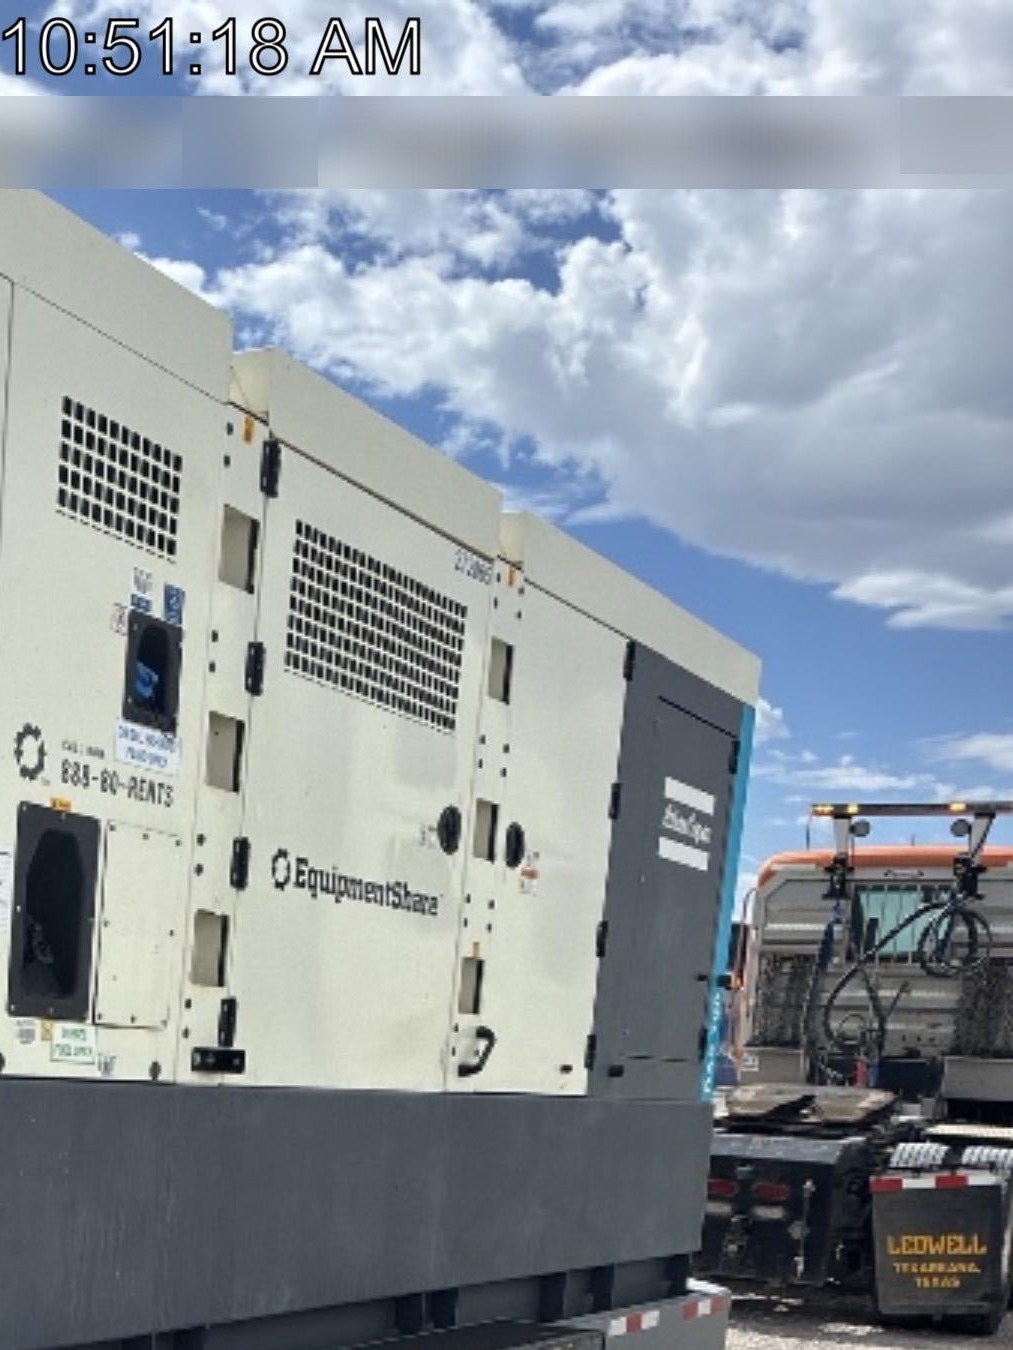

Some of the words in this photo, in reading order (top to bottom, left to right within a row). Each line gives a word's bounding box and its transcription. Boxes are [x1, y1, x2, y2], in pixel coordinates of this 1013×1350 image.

[60, 758, 175, 808] 888-80-RENTS
[293, 857, 438, 916] EquipmentShare
[886, 1234, 988, 1255] LEDWELL
